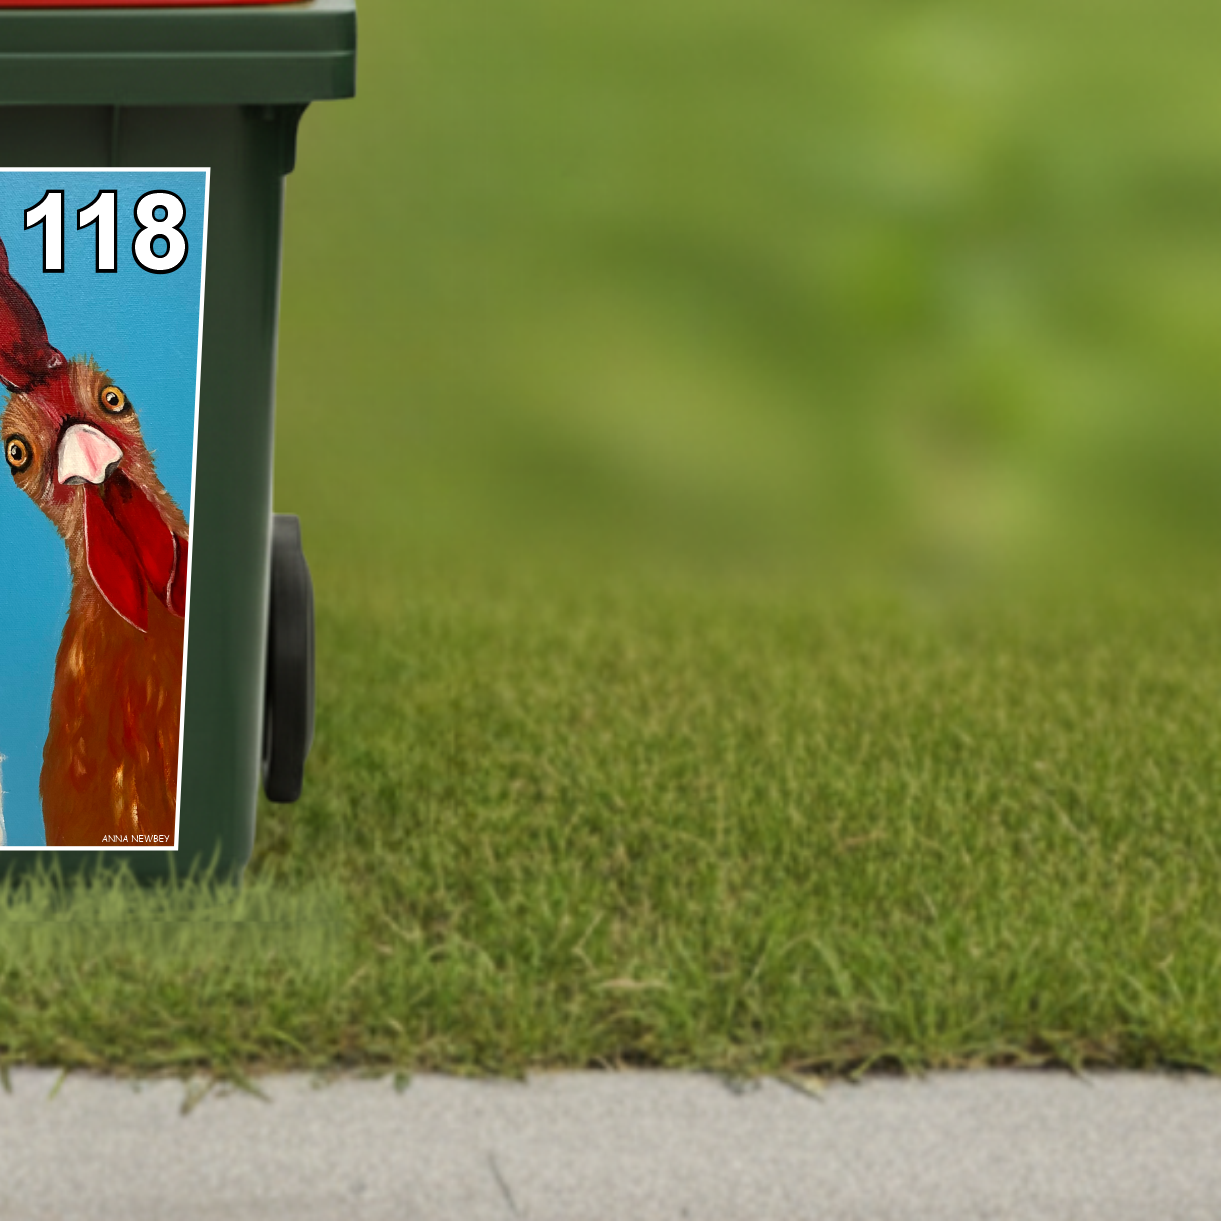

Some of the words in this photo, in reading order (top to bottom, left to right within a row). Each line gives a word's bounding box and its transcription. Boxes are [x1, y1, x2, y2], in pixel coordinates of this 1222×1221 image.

[24, 189, 189, 274] 118
[101, 834, 128, 842] ANNA
[131, 834, 170, 842] NEWBEY
